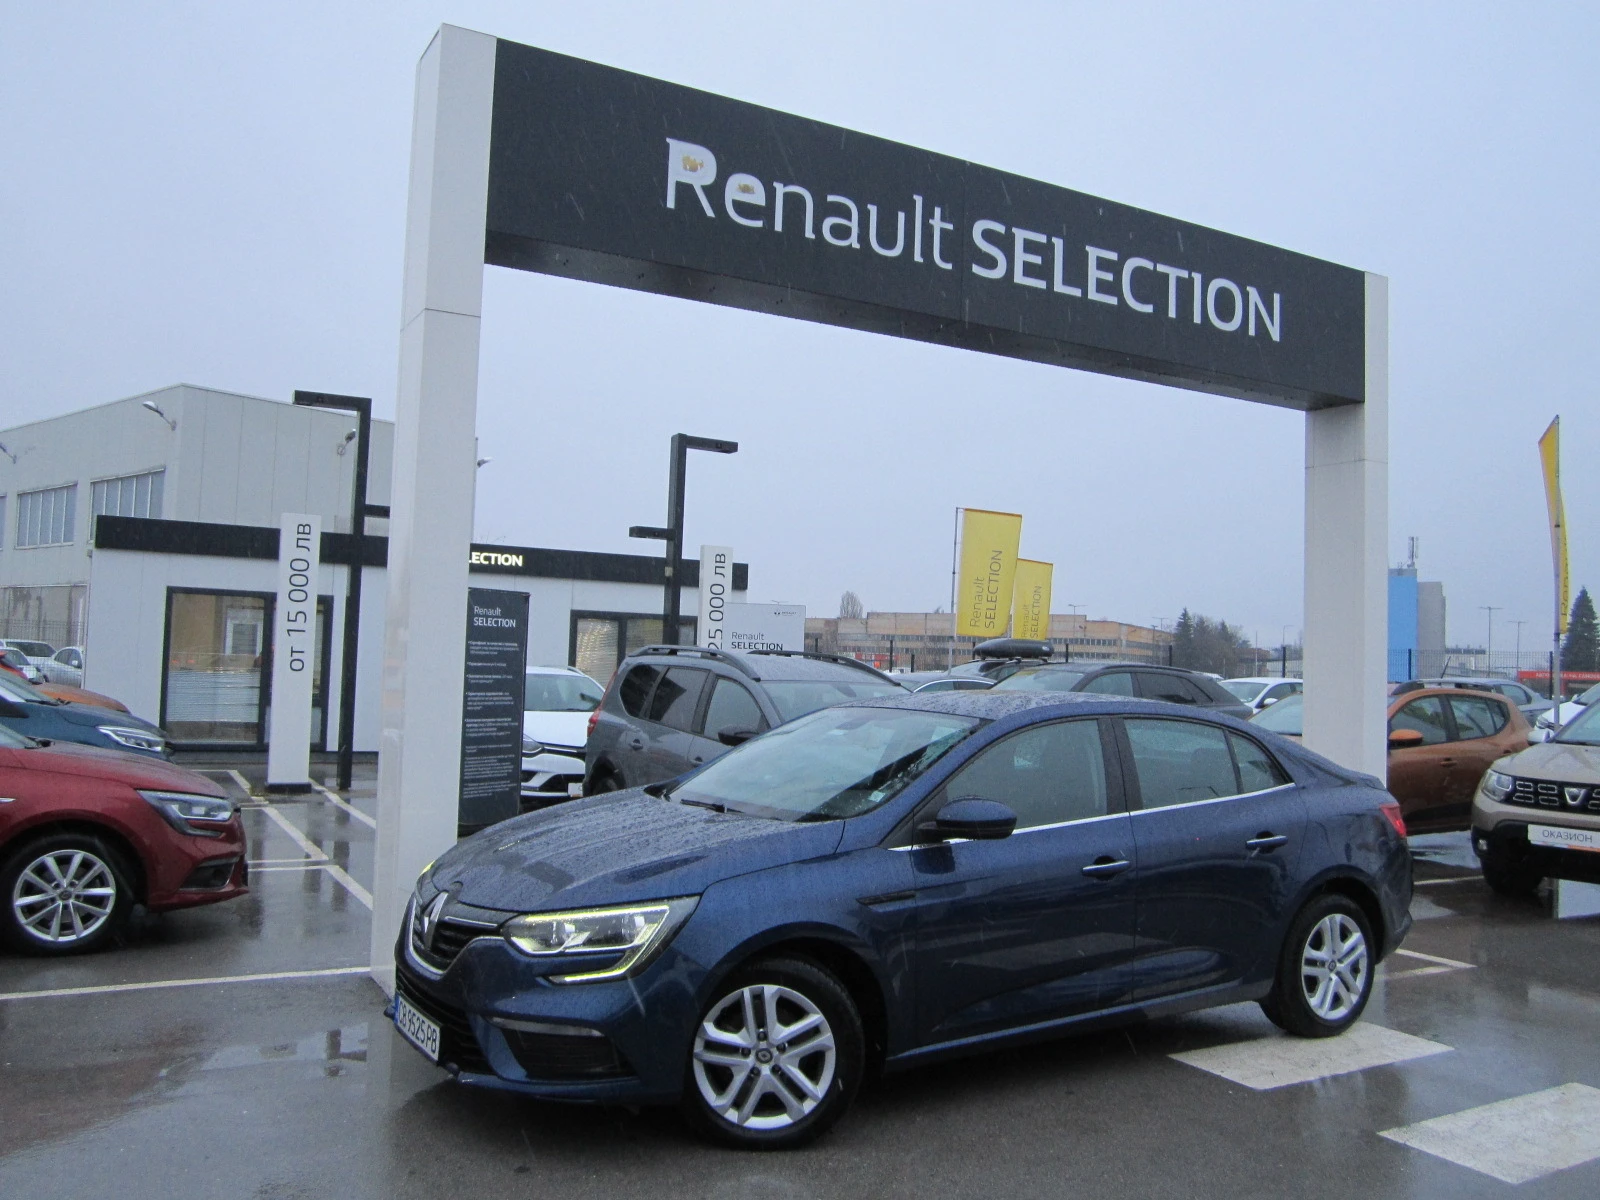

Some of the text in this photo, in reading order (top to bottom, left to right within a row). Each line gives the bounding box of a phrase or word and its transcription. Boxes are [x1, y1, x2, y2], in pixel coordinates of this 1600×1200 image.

[665, 137, 1282, 343] Renault SELECTION
[469, 551, 523, 567] ECTION
[288, 558, 310, 603] 000
[985, 549, 1003, 629] SELECTION
[474, 605, 502, 616] Renault
[709, 583, 725, 622] 000
[969, 576, 985, 628] Renault
[1030, 585, 1042, 639] SELECTION
[286, 610, 308, 637] 15
[473, 617, 516, 628] SELECTION
[1021, 604, 1030, 638] Renault
[708, 628, 723, 651] 25
[731, 631, 765, 641] Renault
[731, 641, 784, 653] SELECTION
[1541, 829, 1593, 843] ОКАЗИОН
